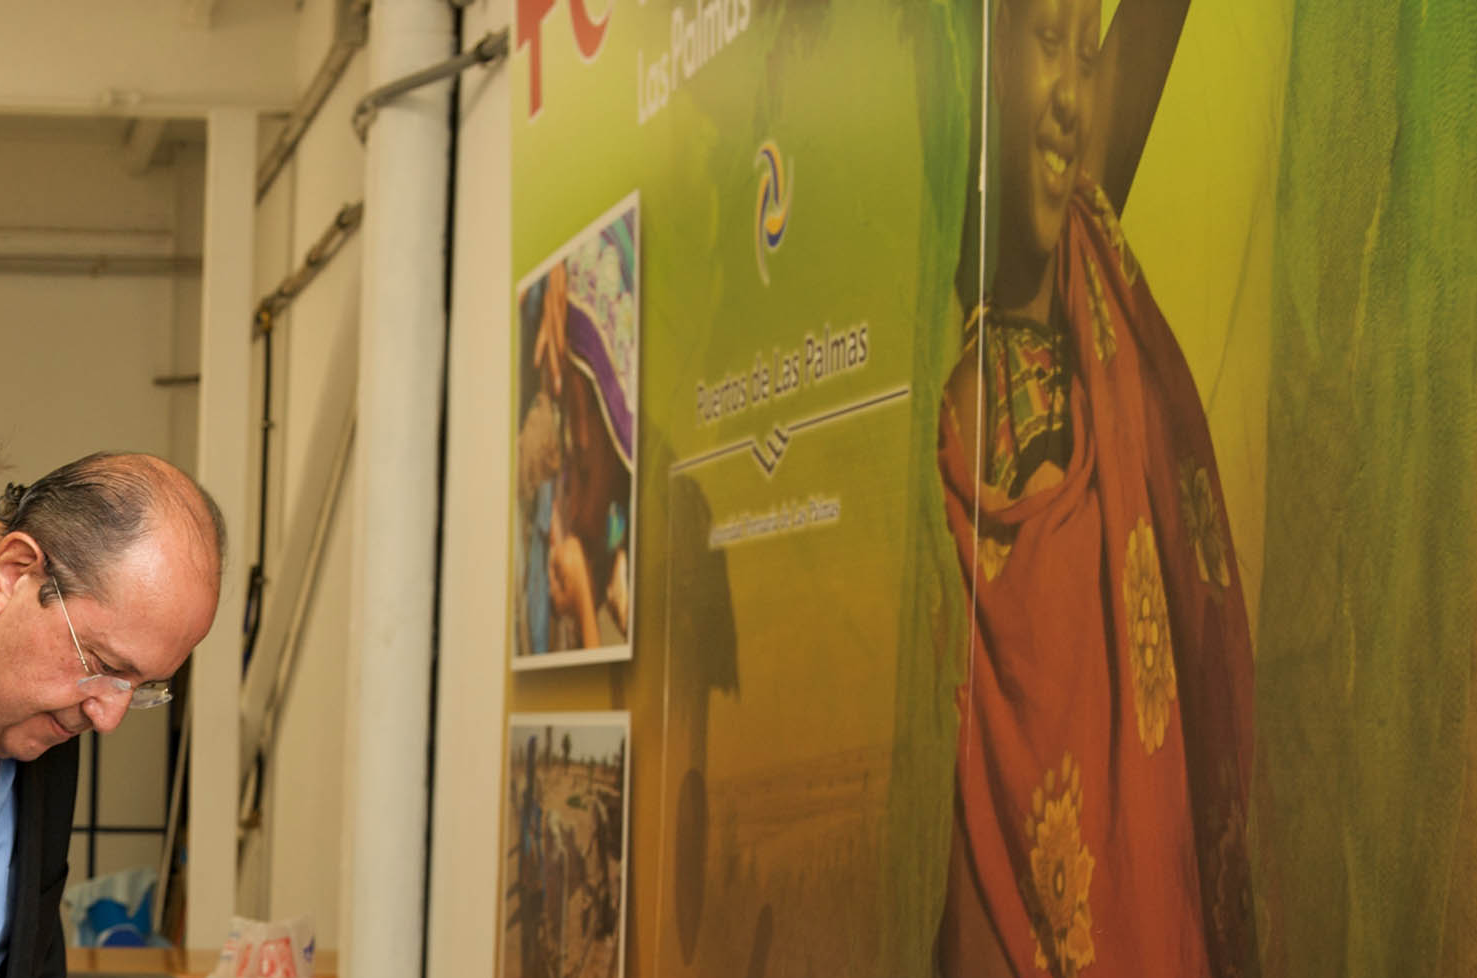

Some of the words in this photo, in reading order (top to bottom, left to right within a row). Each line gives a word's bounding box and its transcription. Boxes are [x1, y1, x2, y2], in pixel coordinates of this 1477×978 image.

[671, 0, 751, 90] Palmas
[696, 377, 747, 427] Puertos
[751, 353, 770, 402] de
[773, 349, 799, 395] Las
[804, 323, 868, 383] Palmas
